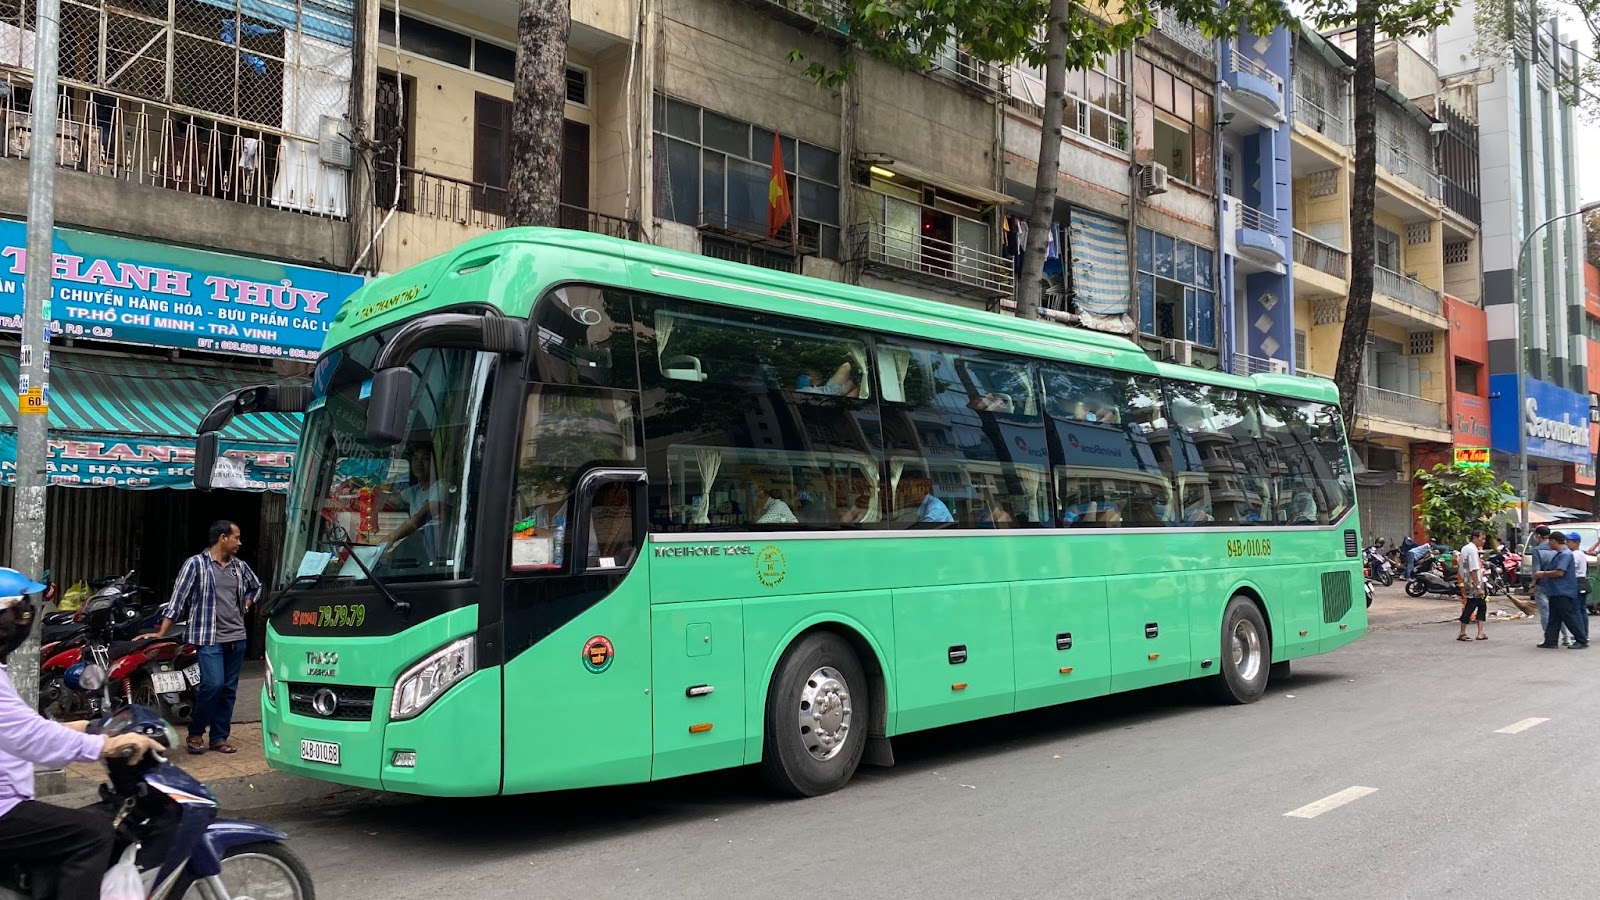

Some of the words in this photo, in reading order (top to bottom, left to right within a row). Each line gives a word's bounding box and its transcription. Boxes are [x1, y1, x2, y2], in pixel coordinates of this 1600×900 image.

[2, 246, 191, 297] THANH
[204, 279, 329, 314] THỦY
[60, 287, 123, 307] CHUYỂN
[129, 295, 169, 313] HÀNG
[174, 301, 203, 317] HÓA
[218, 307, 246, 322] BƯU
[250, 310, 289, 327] PHẨM
[292, 316, 318, 331] CÁC
[121, 313, 152, 326] CHÍ
[154, 317, 194, 331] MINH
[207, 321, 239, 336] TRÀ
[242, 327, 278, 341] VINH
[28, 396, 41, 406] 60
[1526, 397, 1590, 447] Sacombank
[88, 463, 159, 475] HÀNG
[654, 545, 721, 558] MOBIHOME
[318, 604, 366, 627] 79.79.79
[301, 741, 338, 764] 84B-010.68
